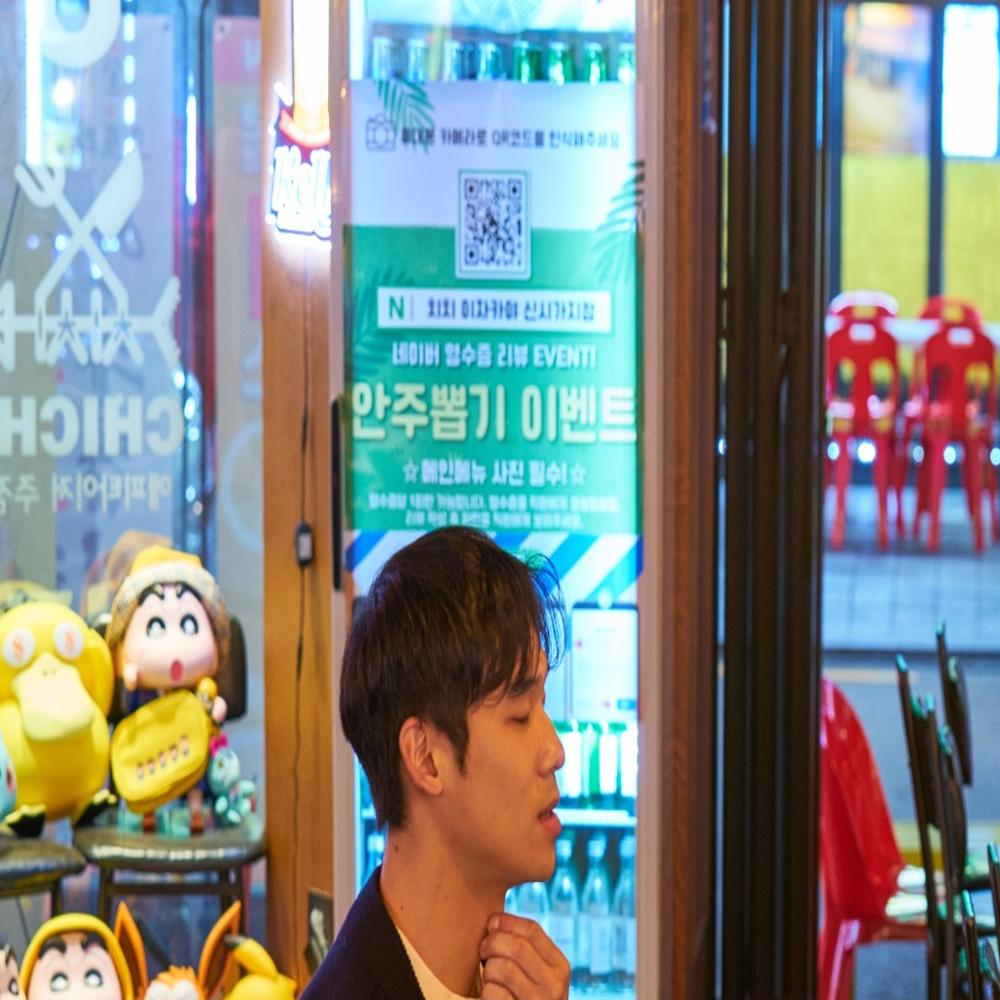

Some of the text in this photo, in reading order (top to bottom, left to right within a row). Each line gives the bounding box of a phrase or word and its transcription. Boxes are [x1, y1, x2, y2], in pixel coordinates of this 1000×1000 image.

[389, 297, 404, 318] N
[461, 299, 518, 319] 이자카야
[392, 341, 440, 367] 네이버
[497, 343, 528, 368] 리뷰
[352, 382, 636, 442] 안주뽑기 이벤트
[492, 461, 524, 485] 사진
